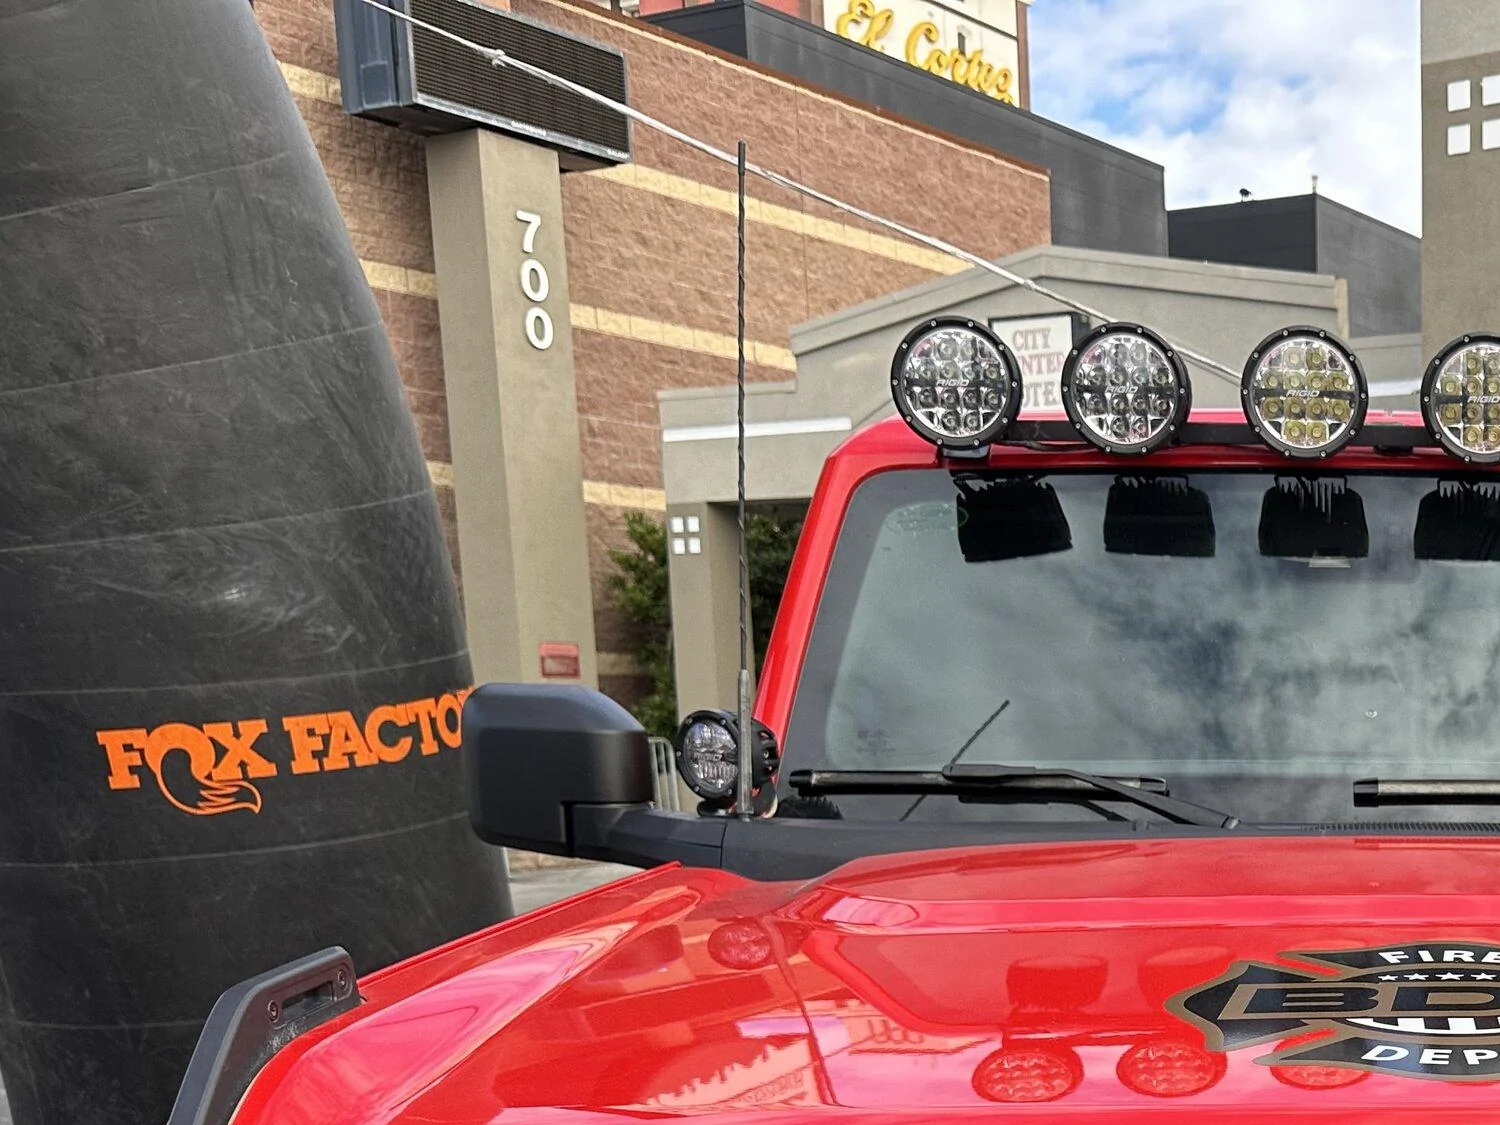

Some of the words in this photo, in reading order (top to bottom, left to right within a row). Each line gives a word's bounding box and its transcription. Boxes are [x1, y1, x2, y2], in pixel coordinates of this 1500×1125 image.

[516, 209, 554, 350] 700
[1012, 327, 1052, 351] CITY
[936, 378, 970, 388] RIGID
[1104, 385, 1139, 394] RIGID
[1285, 388, 1320, 398] RIGID
[1467, 394, 1500, 404] RIGID
[97, 719, 277, 816] FOX
[282, 685, 475, 775] FACTO
